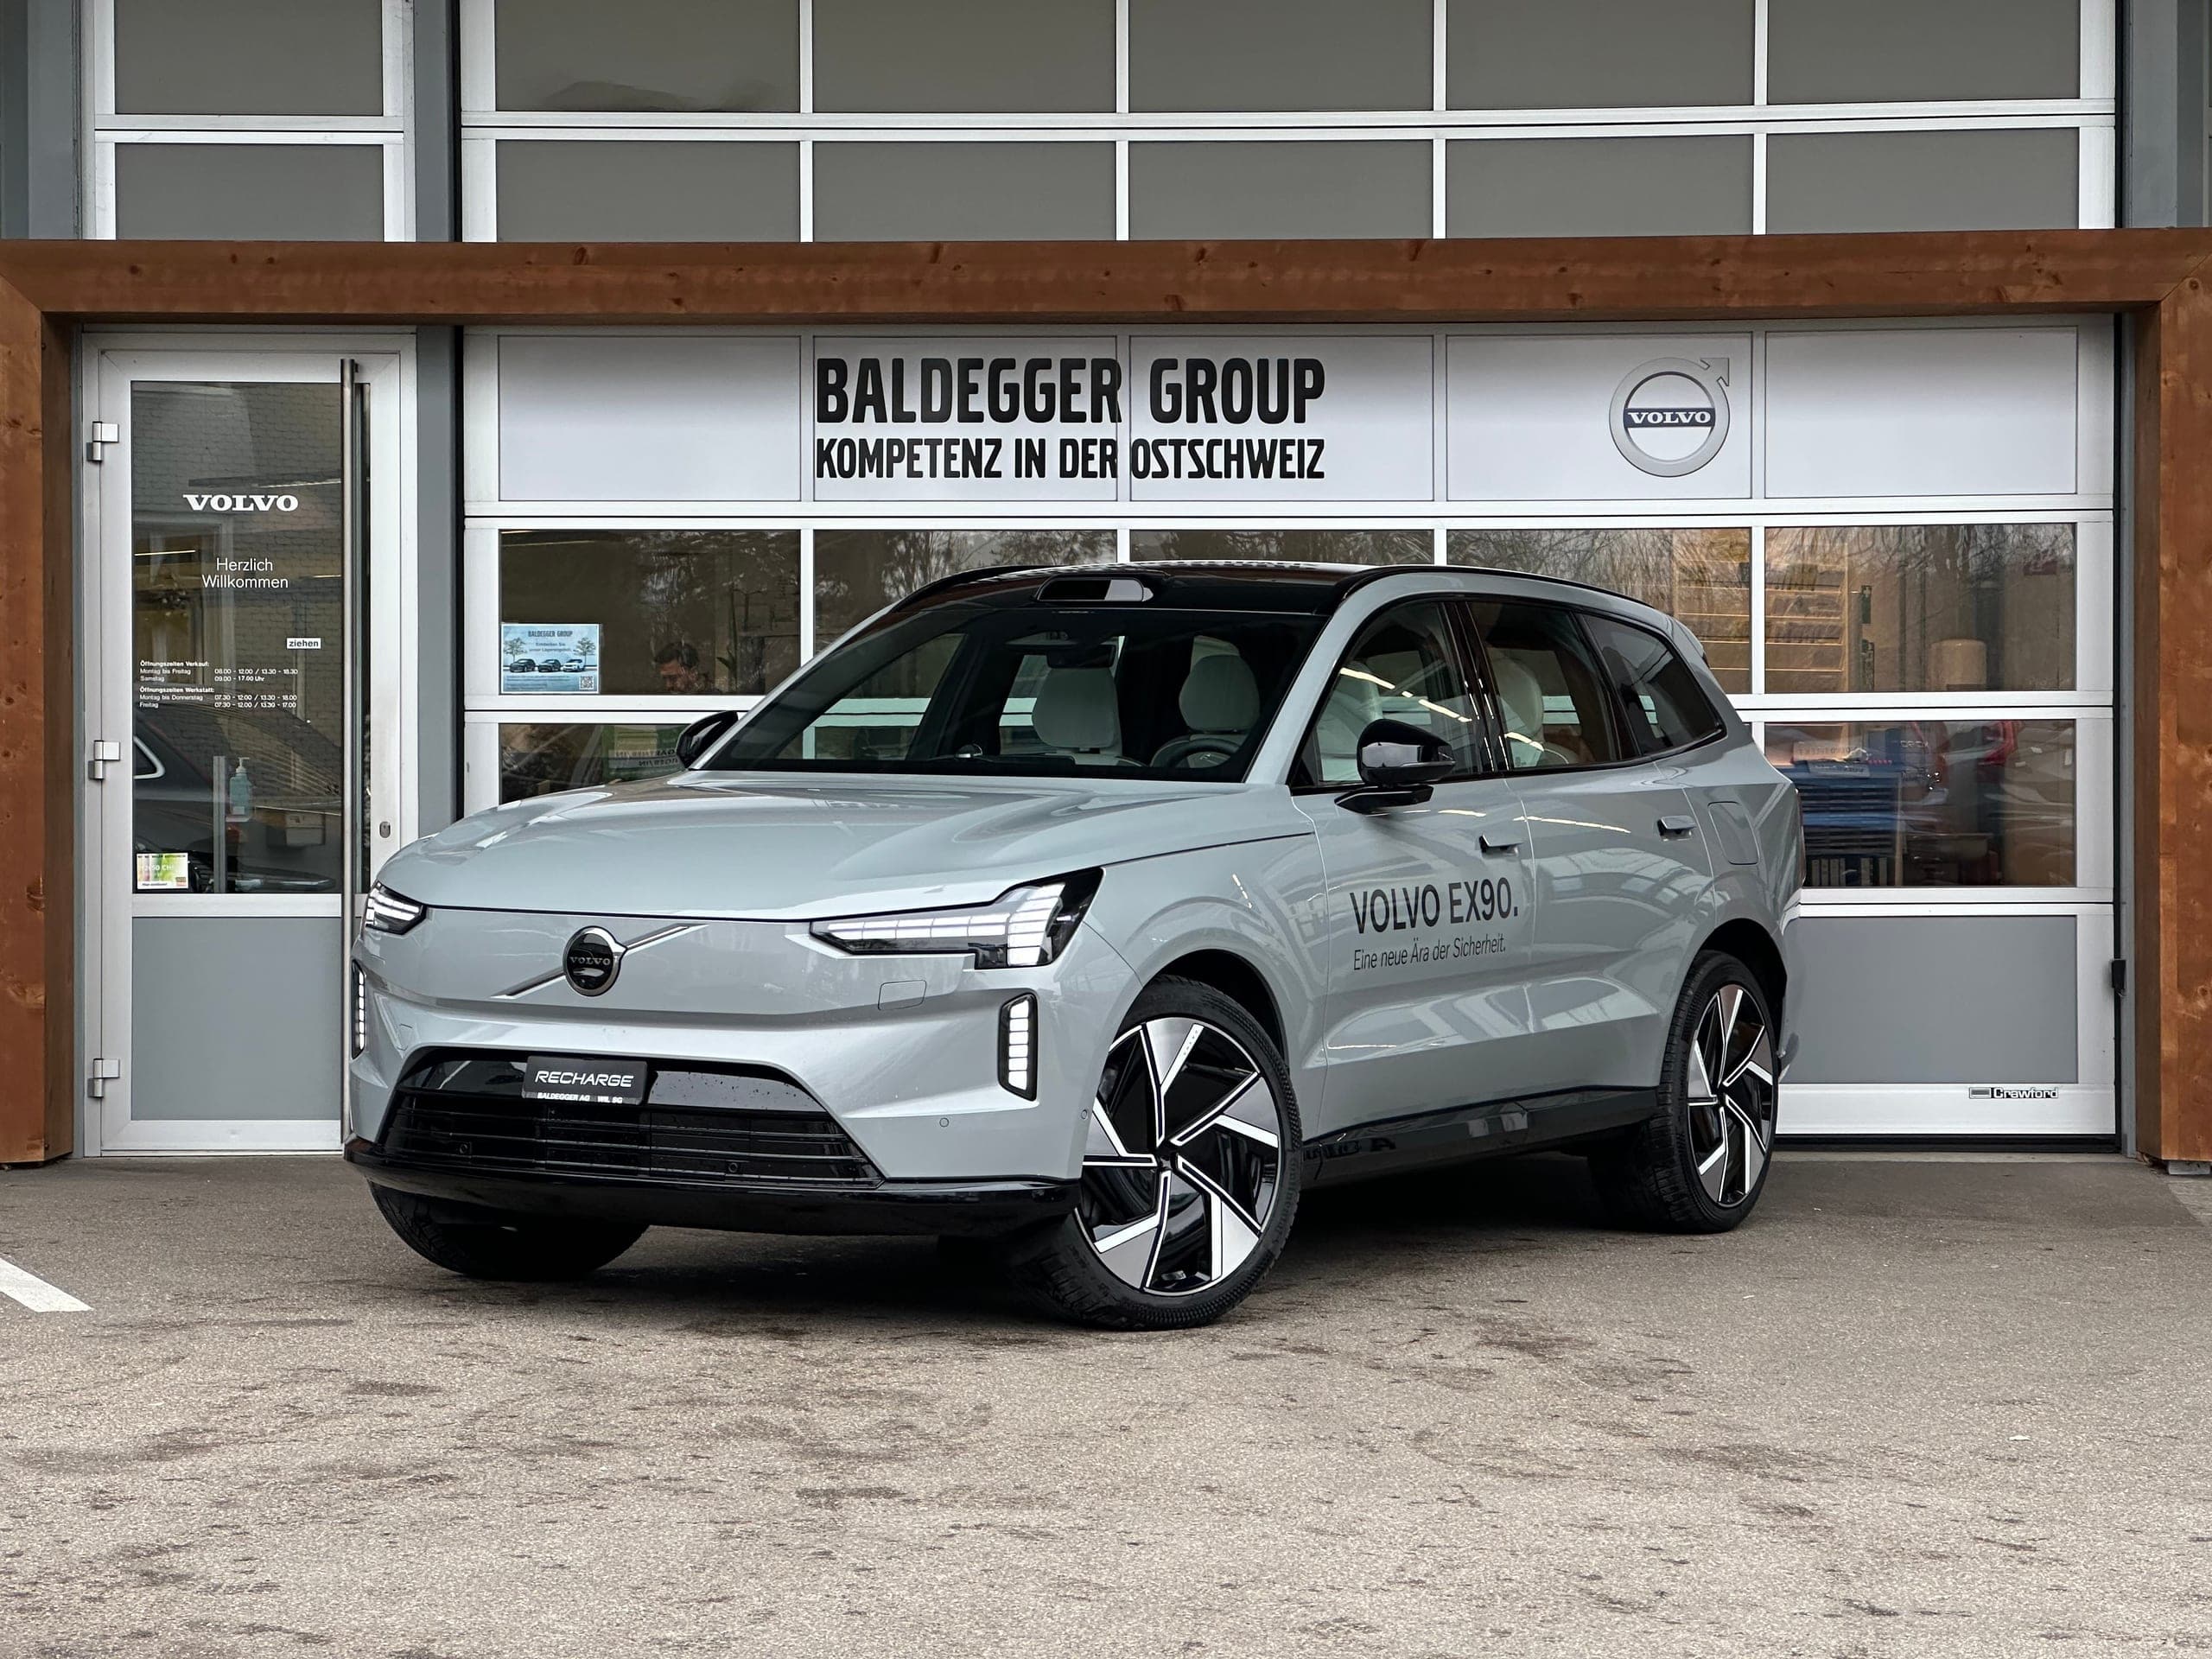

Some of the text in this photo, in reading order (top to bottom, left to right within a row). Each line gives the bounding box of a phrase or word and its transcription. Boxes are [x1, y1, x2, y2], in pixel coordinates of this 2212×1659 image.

[817, 357, 1325, 424] BALDEGGER GROUP
[1628, 411, 1711, 423] VOLVO
[816, 438, 1325, 479] KOMPETENZ IN DER OSTSCHWEIZ
[182, 493, 298, 512] VOLVO
[216, 557, 273, 571] Herzlich
[201, 574, 289, 588] Willkommen
[1350, 877, 1518, 934] VOLVO EX90.
[1353, 933, 1506, 970] Eine neue Ära der Sicherheit.
[569, 956, 611, 966] VOLVO
[535, 1071, 634, 1087] RECHARGE
[537, 1092, 578, 1101] BALDEGGER
[1992, 1087, 2058, 1098] Crawford
